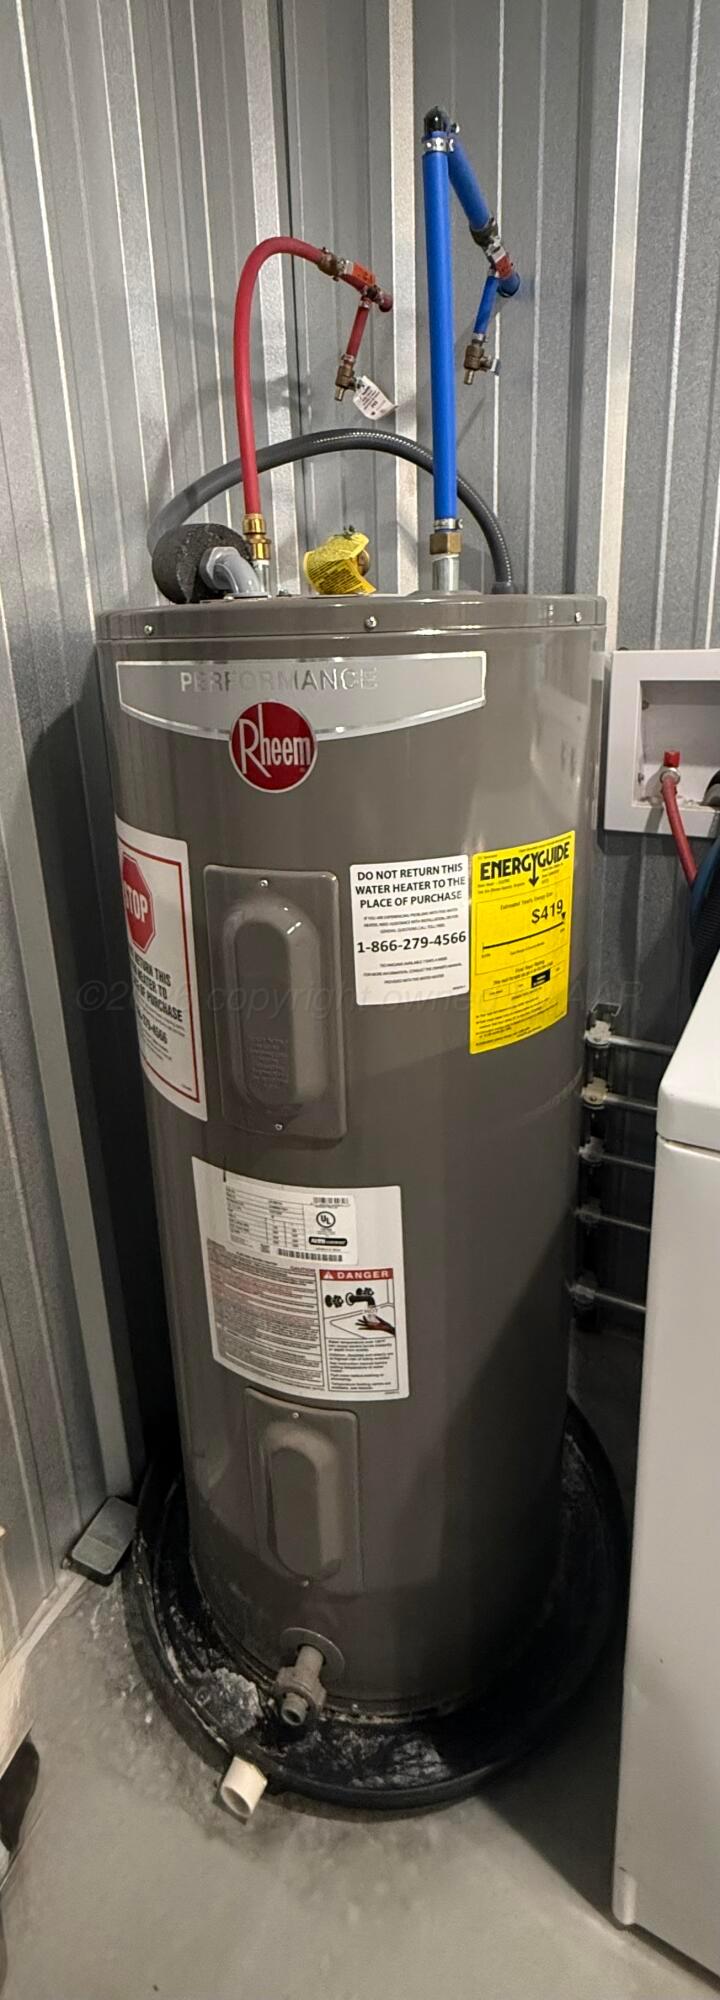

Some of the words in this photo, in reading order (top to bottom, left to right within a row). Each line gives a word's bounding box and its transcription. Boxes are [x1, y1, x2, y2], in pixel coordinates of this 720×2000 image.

[180, 667, 378, 692] PERFORMANCE
[238, 703, 311, 778] Rheem
[480, 841, 570, 881] ENERGYGUIDE
[357, 871, 374, 881] DO
[376, 870, 398, 880] NOT
[400, 865, 440, 878] RETURN
[441, 863, 464, 874] THIS
[355, 884, 391, 895] WATER
[392, 881, 431, 893] HEATER
[432, 879, 446, 889] TO
[447, 876, 467, 887] THE
[359, 898, 393, 909] PLACE
[394, 896, 409, 907] OF
[410, 890, 463, 906] PURCHASE
[356, 931, 466, 954] 1-866-279-4566
[154, 967, 171, 988] THIS
[336, 1270, 390, 1280] DANGER
